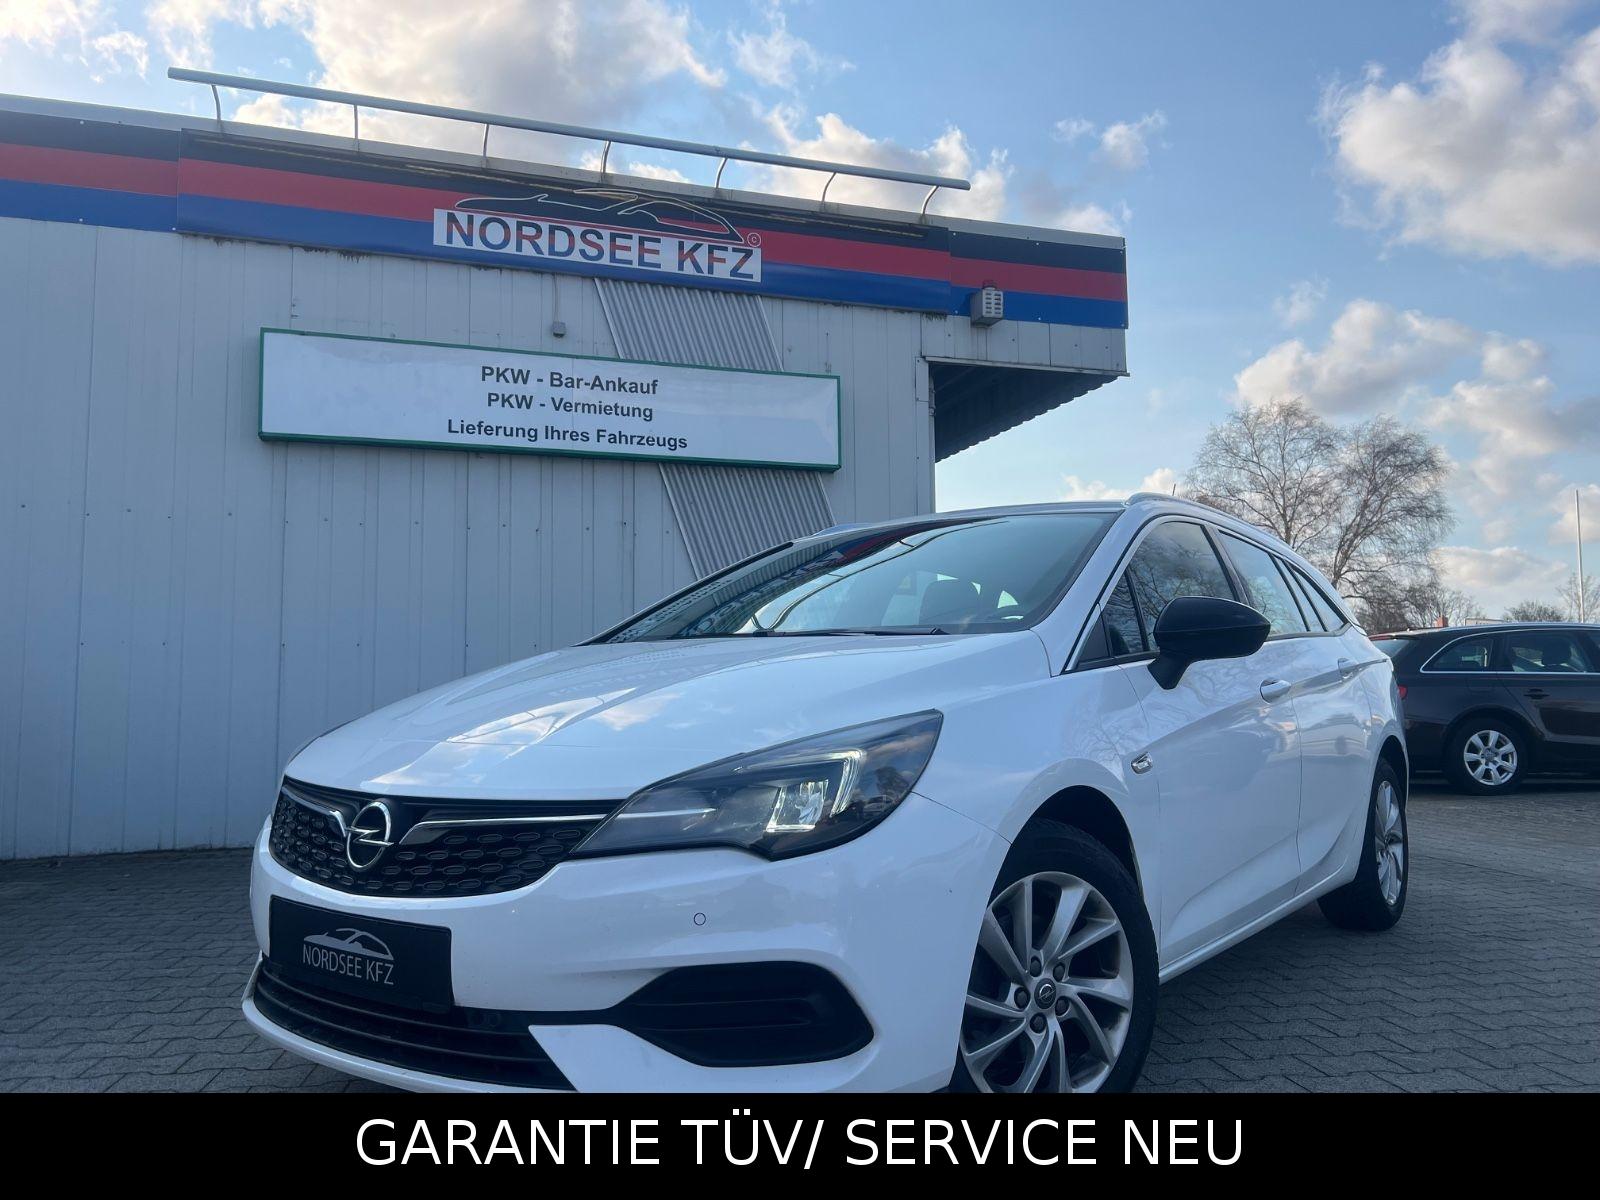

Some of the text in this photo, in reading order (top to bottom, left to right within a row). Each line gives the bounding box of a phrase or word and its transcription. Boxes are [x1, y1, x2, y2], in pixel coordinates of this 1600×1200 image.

[445, 211, 754, 279] NORDSEE KFZ
[481, 366, 531, 385] PKW
[550, 372, 658, 394] Bar-Ankauf
[487, 392, 533, 409] PKW
[551, 397, 653, 421] Vermietung
[448, 419, 688, 451] Lieferung Ihres Fahrzeugs
[302, 944, 394, 985] NORDSEE KFZ
